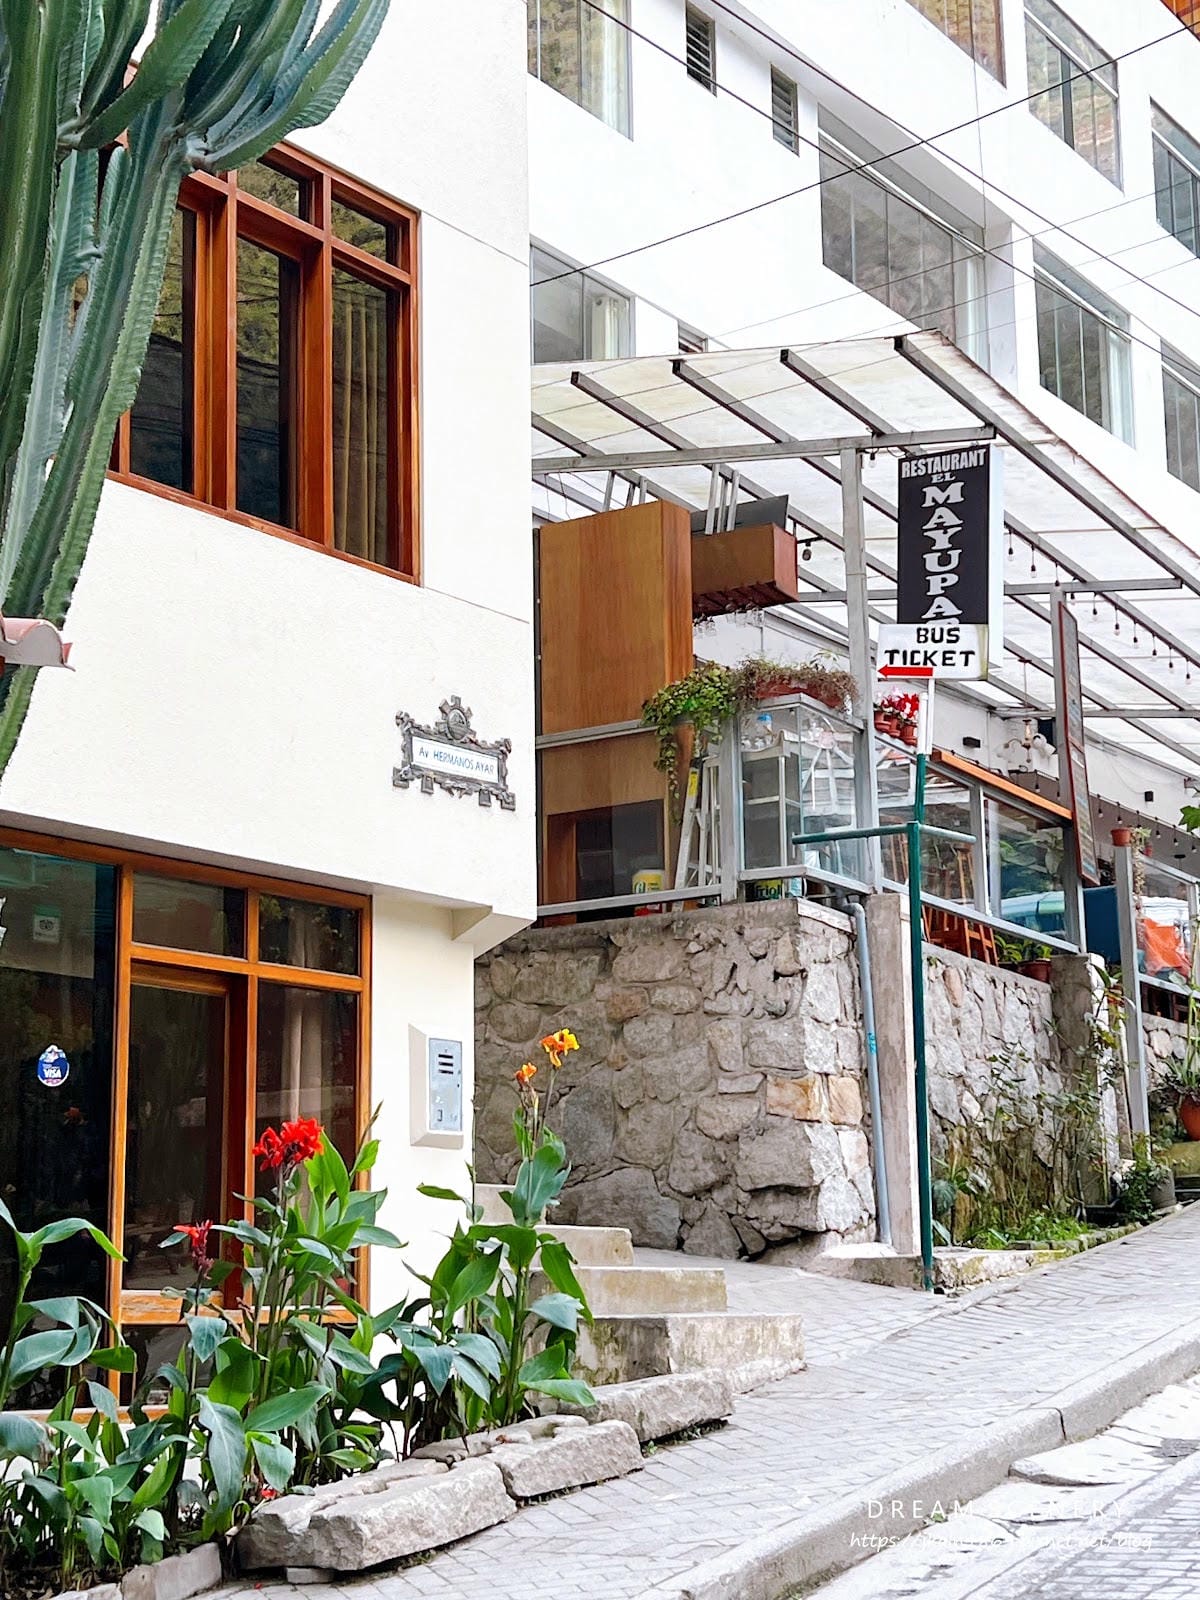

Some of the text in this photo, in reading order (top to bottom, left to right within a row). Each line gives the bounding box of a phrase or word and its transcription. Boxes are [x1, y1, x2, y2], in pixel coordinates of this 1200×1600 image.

[901, 449, 986, 479] RESTAURANT
[931, 472, 956, 484] EL
[916, 627, 961, 644] BUS
[884, 649, 976, 667] TICKET
[433, 750, 474, 770] HERMANOS
[475, 761, 495, 774] AYAR
